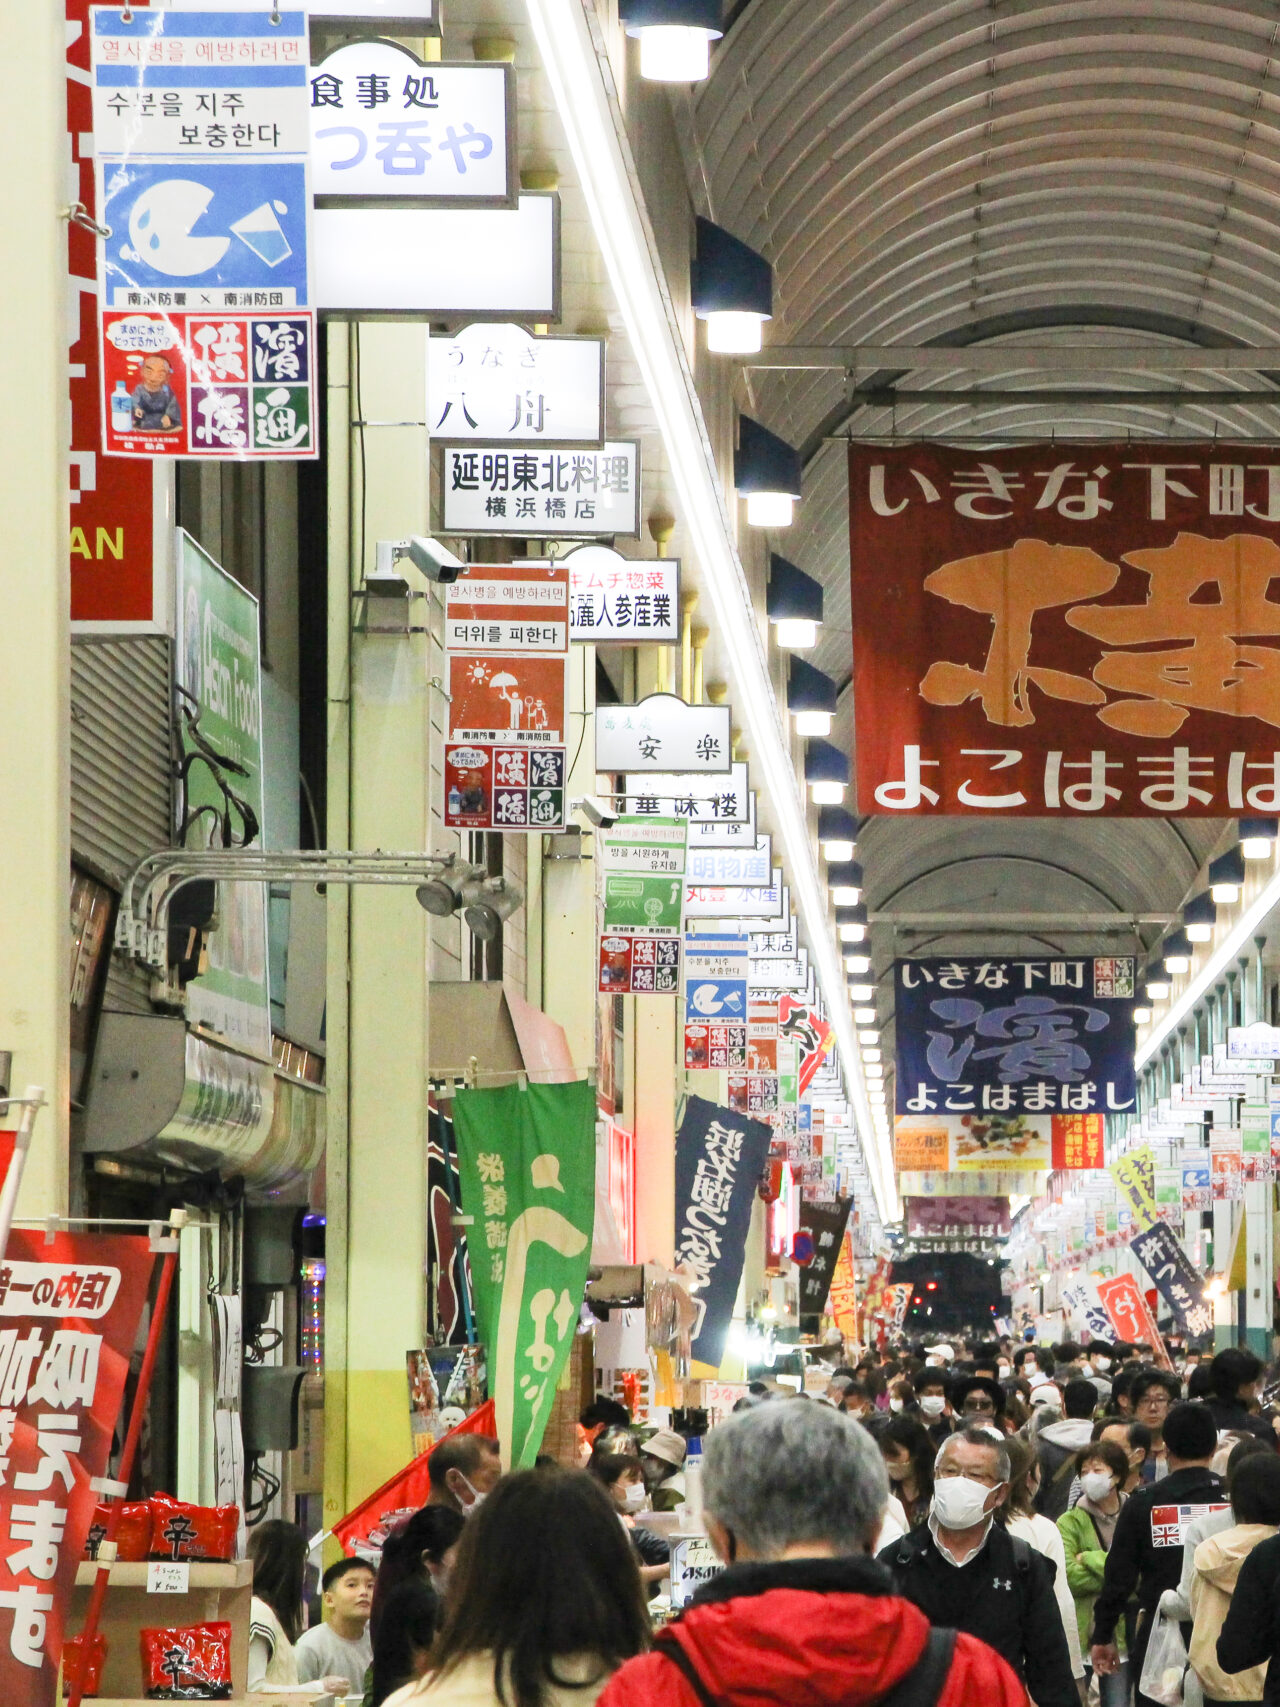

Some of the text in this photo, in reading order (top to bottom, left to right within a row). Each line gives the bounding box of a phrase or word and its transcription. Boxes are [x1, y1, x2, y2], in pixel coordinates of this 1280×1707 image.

[196, 40, 299, 62] 예방하려면
[310, 74, 439, 108] 食事処
[179, 123, 282, 148] 보충한다
[224, 292, 283, 306] 南消防団
[448, 346, 540, 369] うなぎ
[436, 390, 551, 433] 八舟
[451, 453, 629, 494] 延明東北料理
[485, 496, 596, 519] 横浜橋店
[449, 586, 563, 600] 열사병을 예방하려면
[570, 594, 671, 628] 麗人参産業
[455, 625, 558, 644] 더위를 피한다
[639, 734, 721, 760] 安楽
[687, 856, 767, 879] 明物産
[901, 961, 1084, 989] いきな下町
[906, 1081, 1134, 1111] よこはまばし
[164, 1514, 198, 1561] 辛
